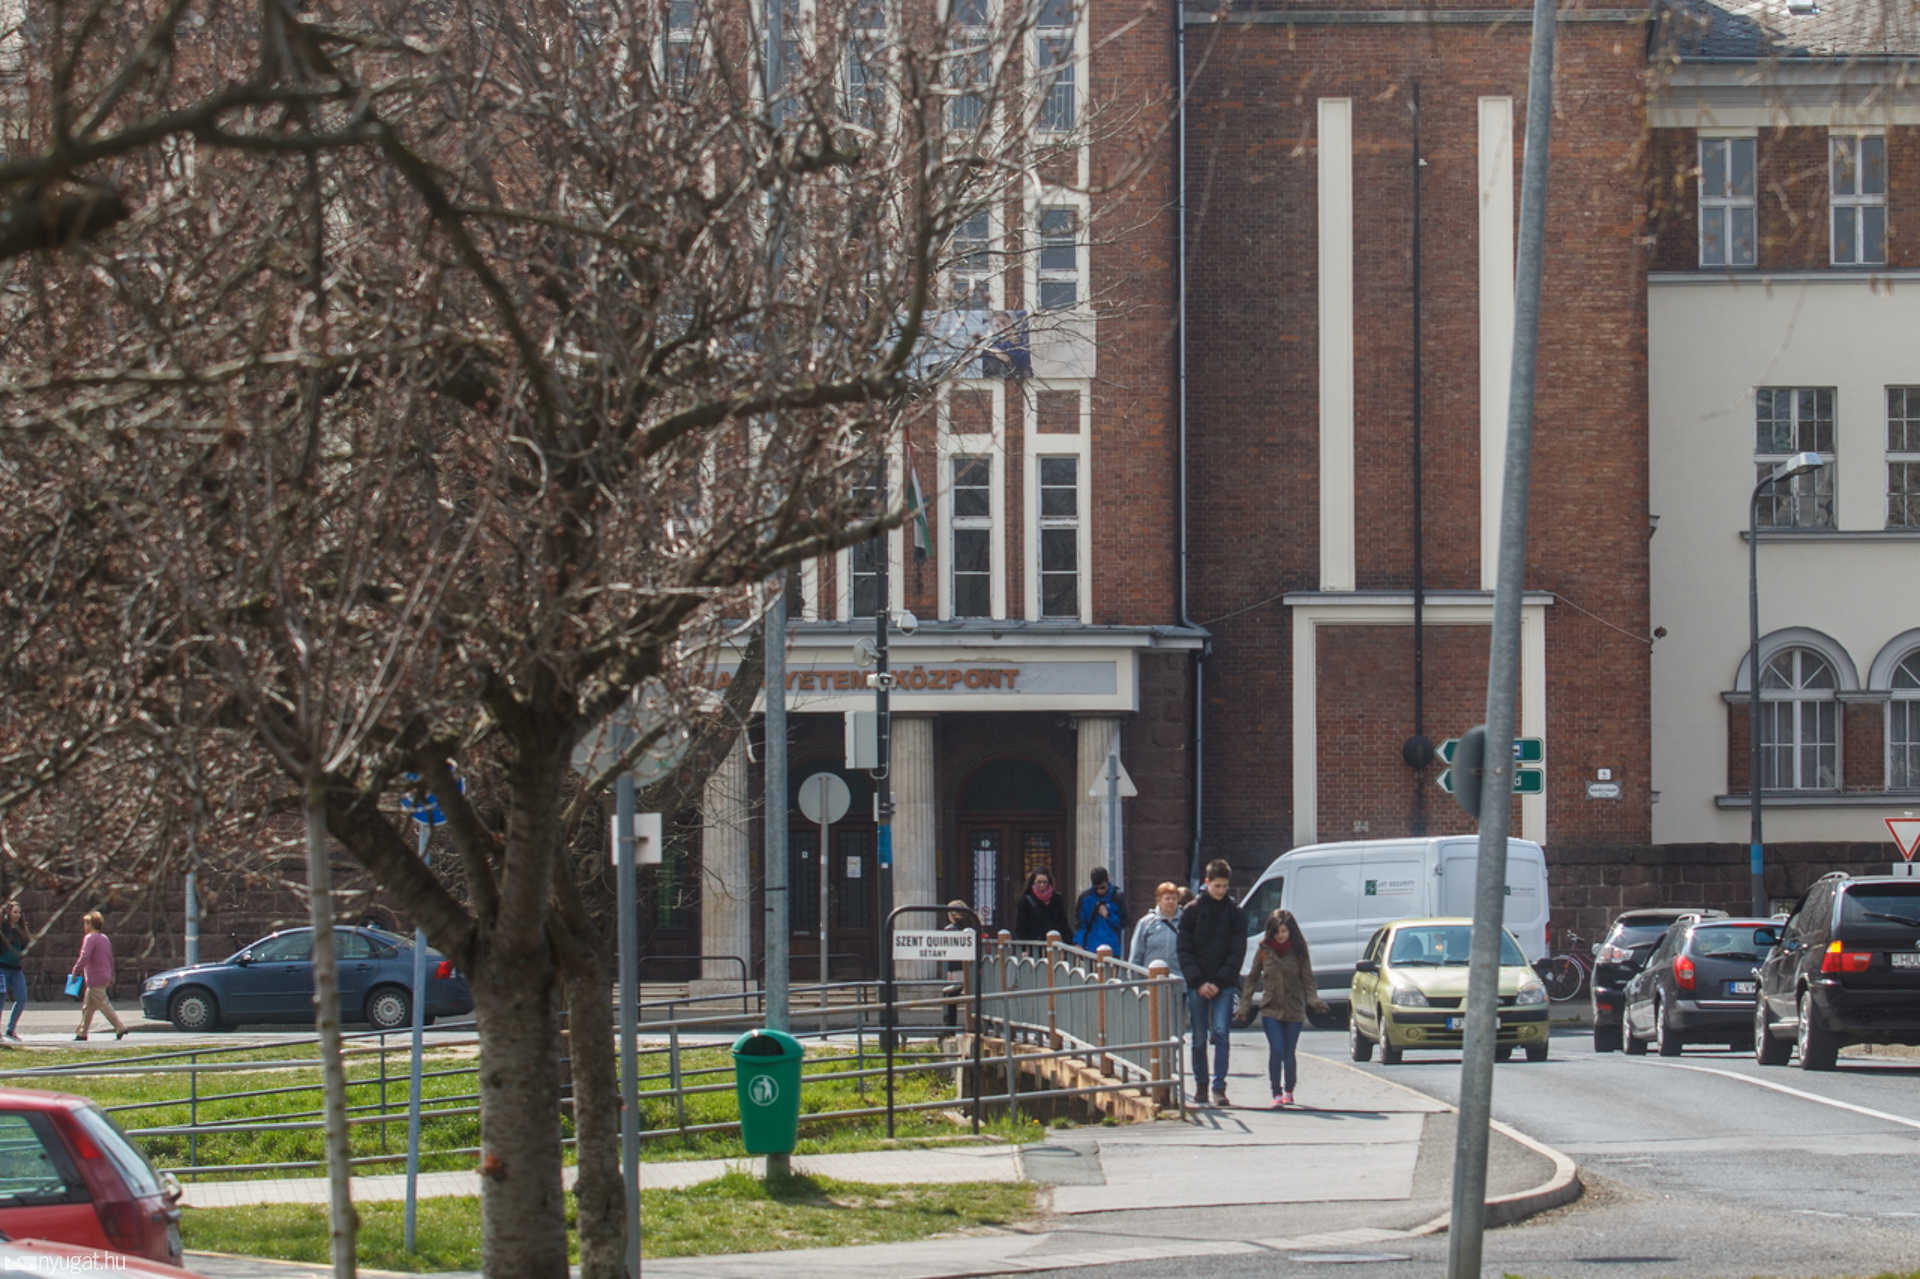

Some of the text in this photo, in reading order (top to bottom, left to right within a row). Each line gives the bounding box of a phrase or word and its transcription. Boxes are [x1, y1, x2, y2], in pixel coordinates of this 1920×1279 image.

[890, 665, 1020, 690] KÖZPONT
[895, 935, 973, 947] SZENT QUIRINUS
